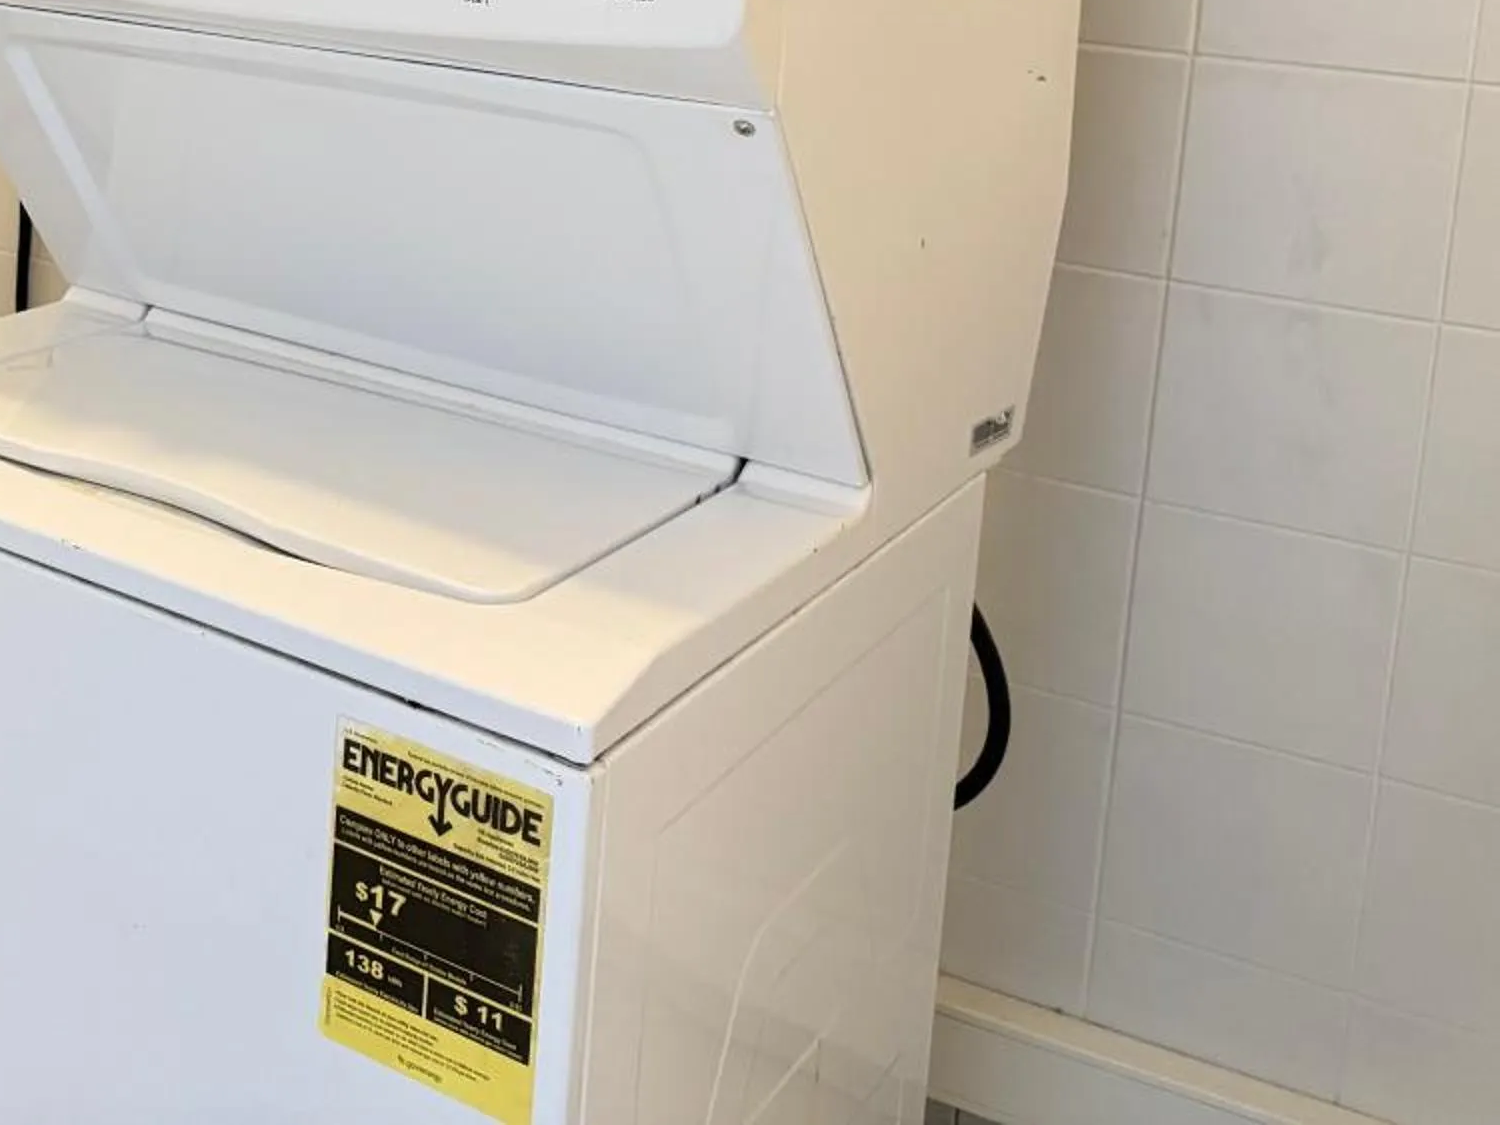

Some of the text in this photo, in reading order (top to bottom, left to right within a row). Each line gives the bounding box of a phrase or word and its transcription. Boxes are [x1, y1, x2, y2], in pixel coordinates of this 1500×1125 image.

[342, 737, 543, 848] ENERGYGUIDE
[355, 881, 406, 917] $17
[344, 950, 385, 980] 138
[478, 1006, 502, 1031] 11
